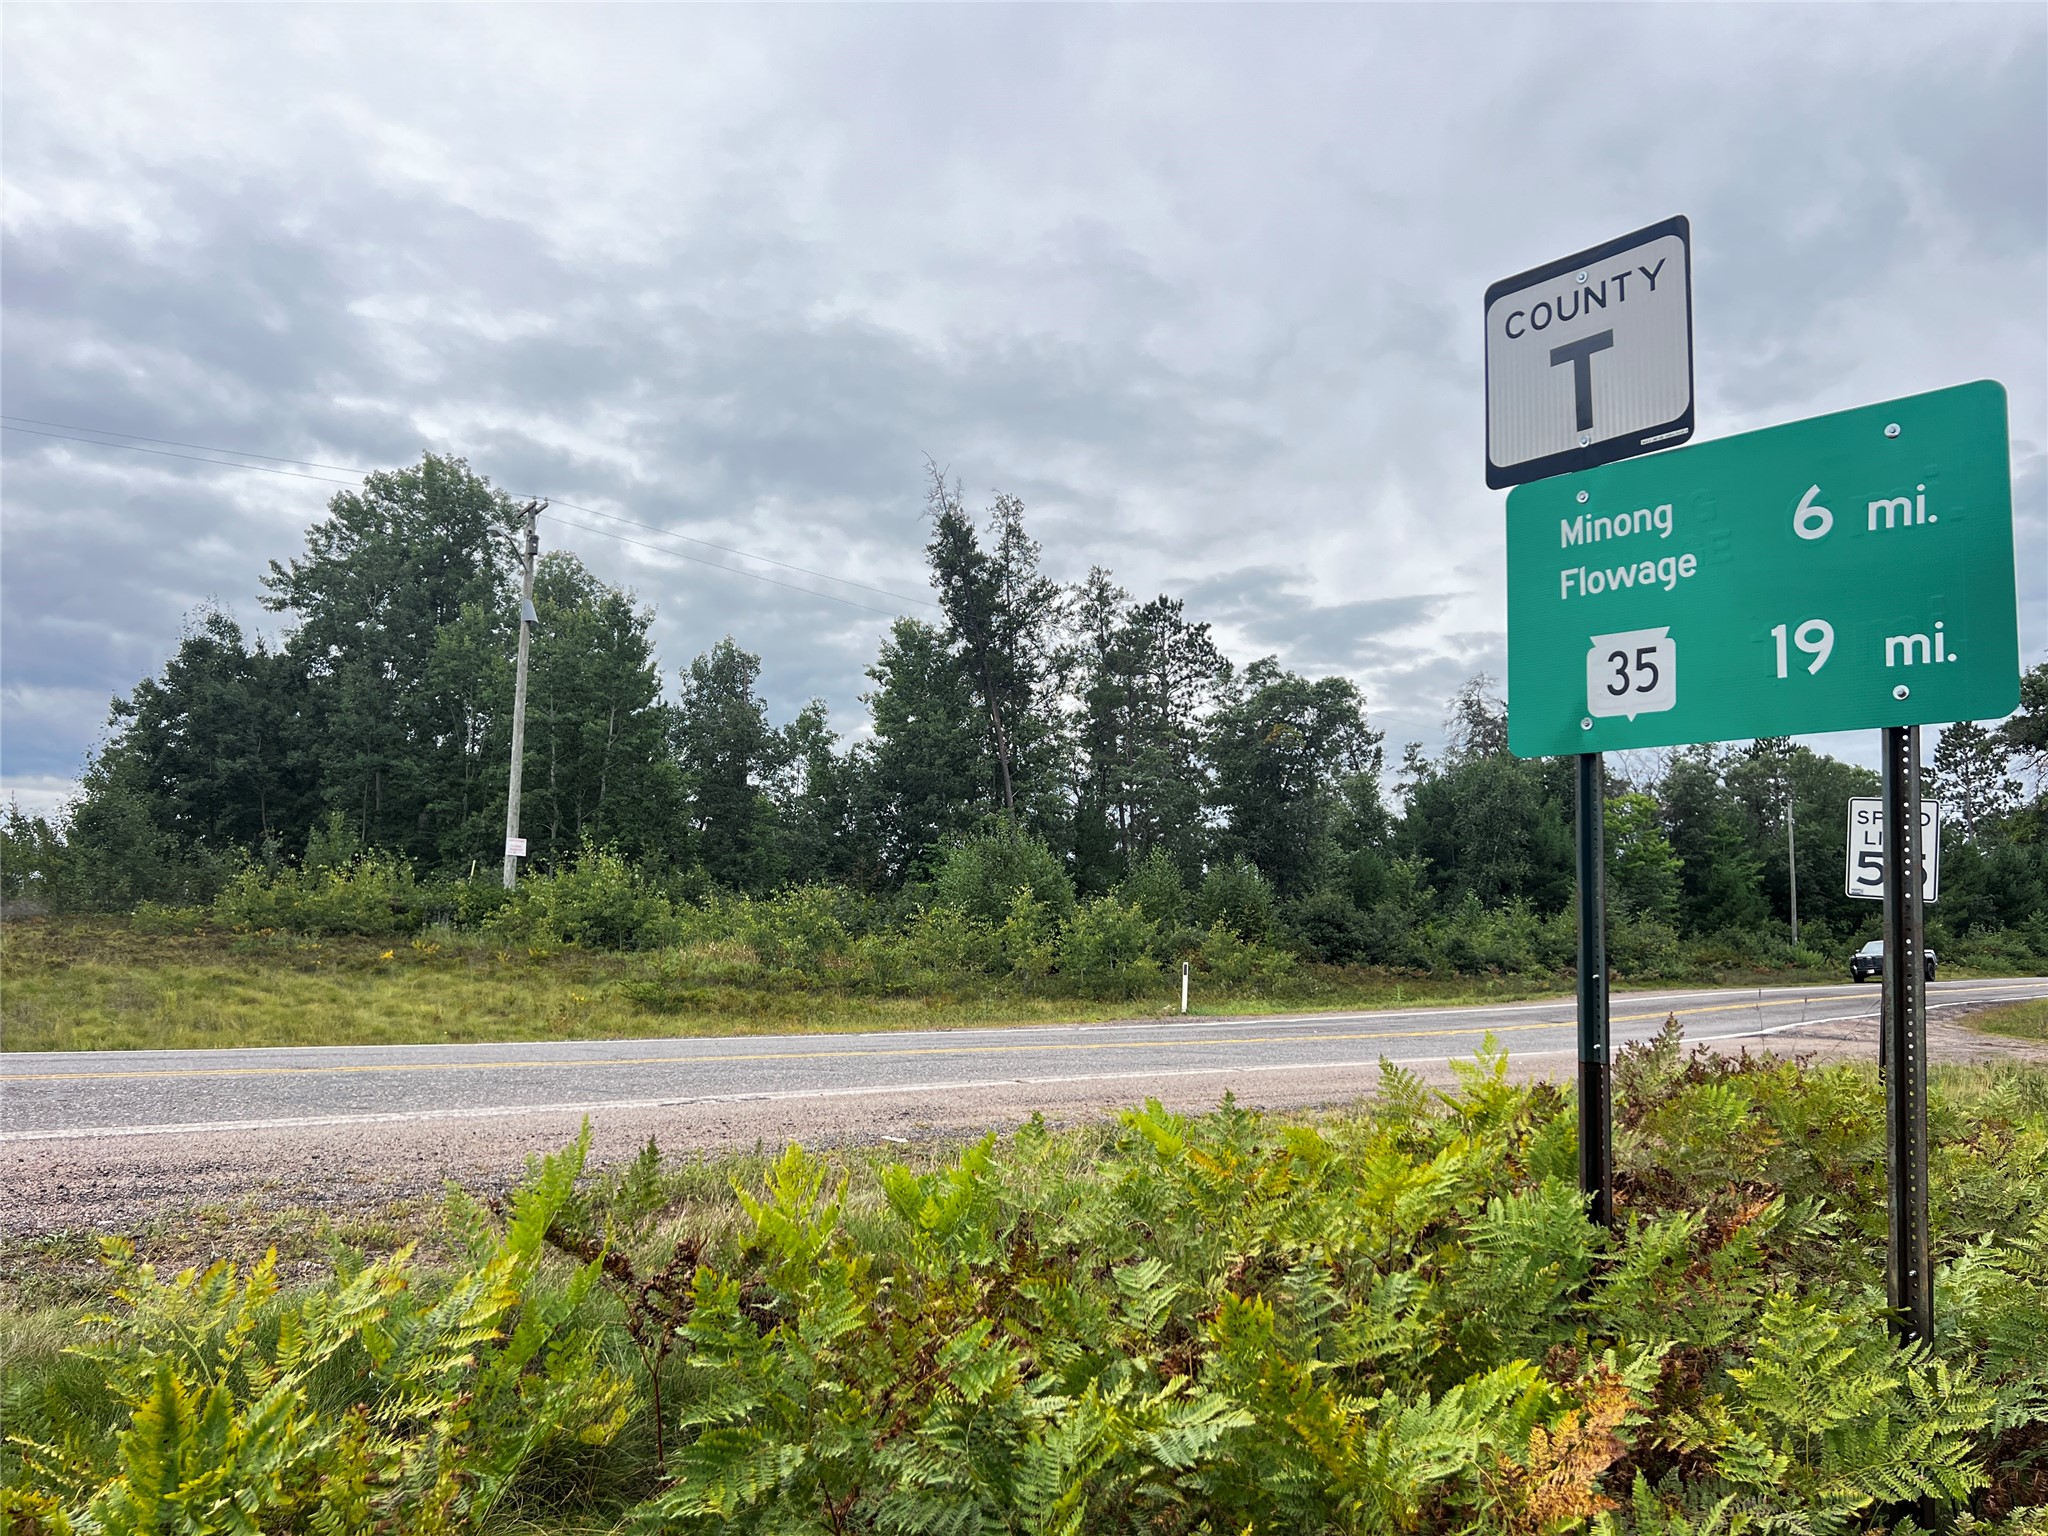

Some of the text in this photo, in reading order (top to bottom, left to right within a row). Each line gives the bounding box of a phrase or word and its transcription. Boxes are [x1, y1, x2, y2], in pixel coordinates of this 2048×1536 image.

[1505, 257, 1666, 339] COUNTY
[1550, 328, 1614, 432] T
[1561, 503, 1673, 548] Minong
[1793, 484, 1834, 540] 6
[1868, 483, 1938, 531] mi.
[1561, 553, 1698, 600] Flowage
[1607, 619, 1957, 696] 35 19 mi.
[1857, 810, 1931, 827] SPD
[1856, 851, 1928, 886] 5
